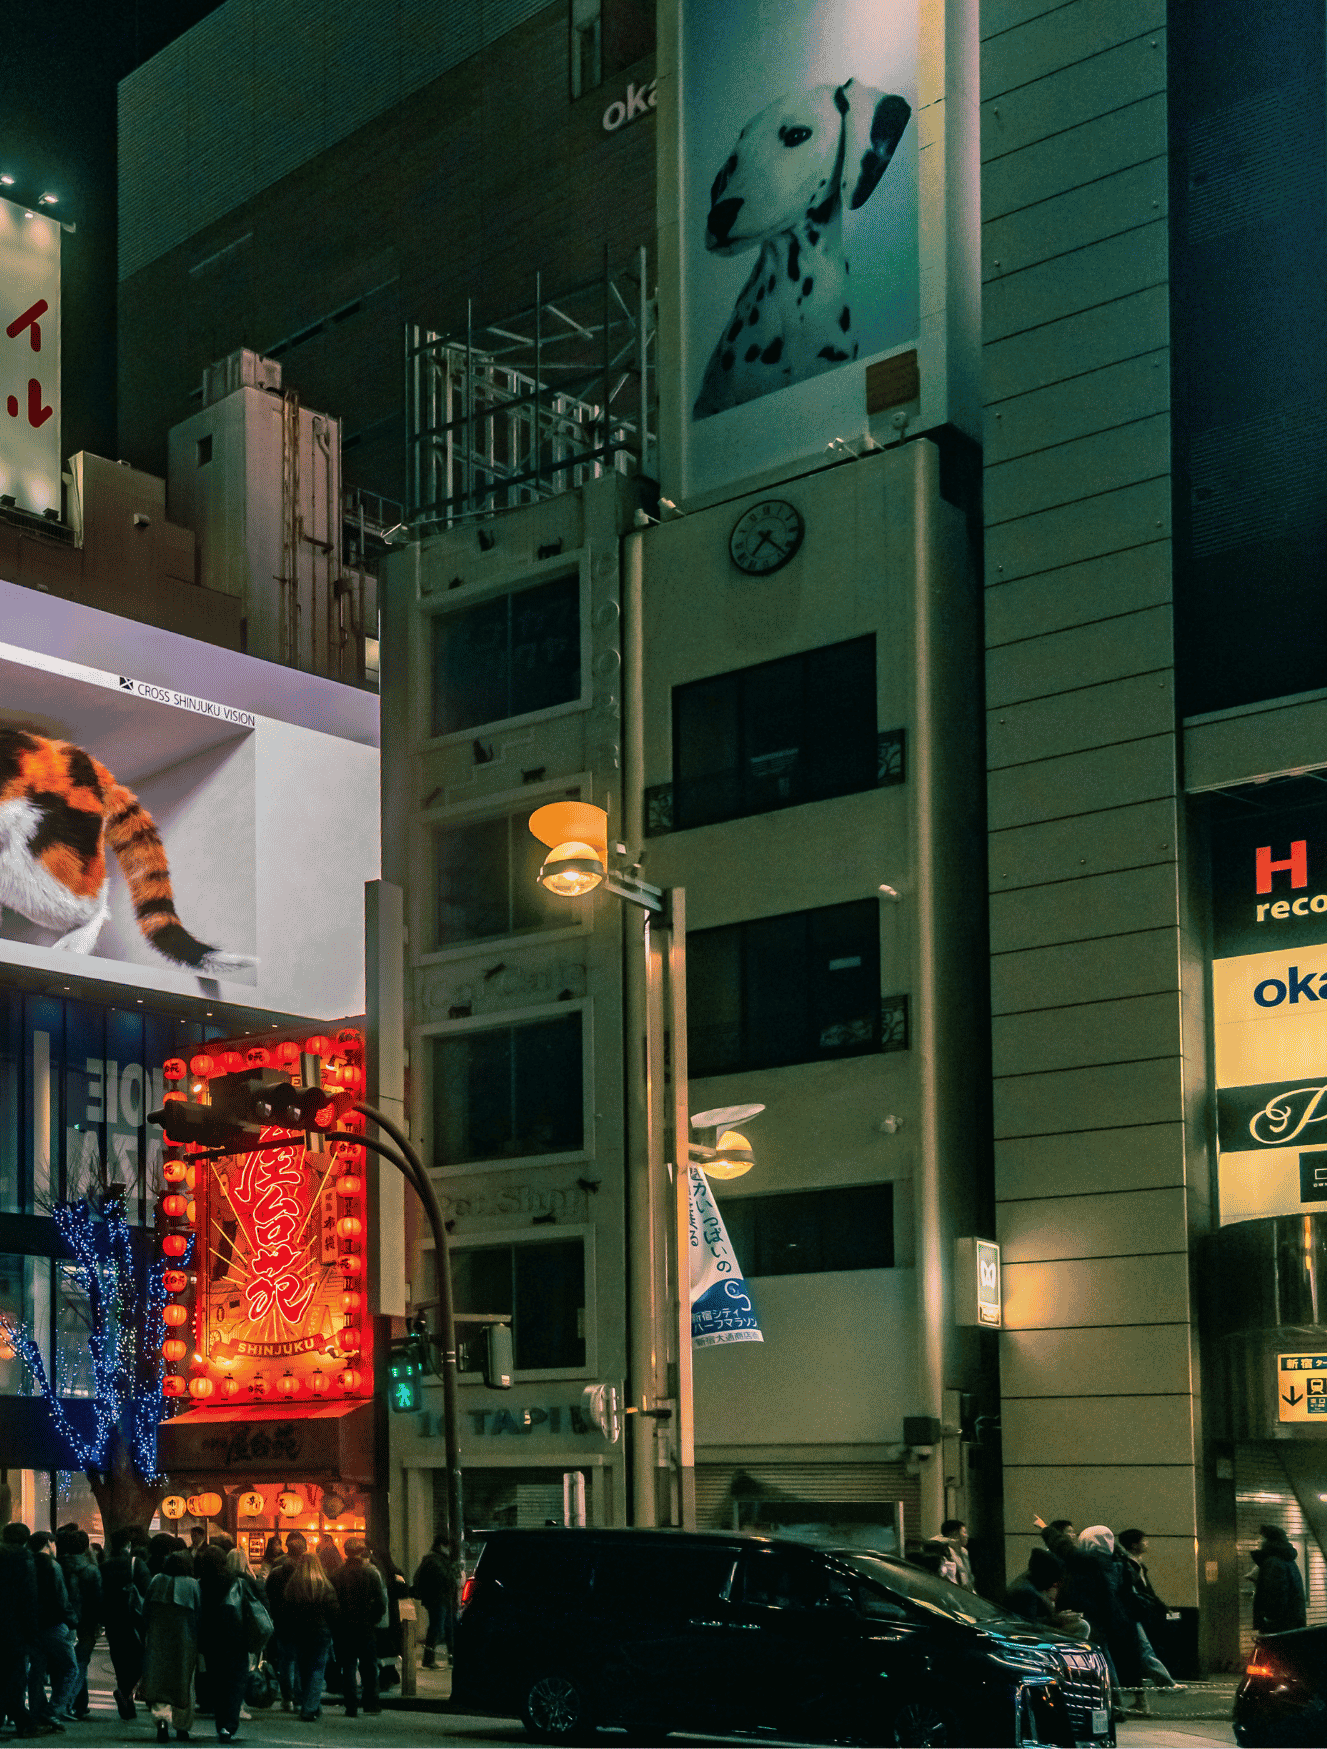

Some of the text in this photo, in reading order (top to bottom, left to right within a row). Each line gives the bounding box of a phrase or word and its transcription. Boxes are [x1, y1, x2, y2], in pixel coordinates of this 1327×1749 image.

[137, 683, 255, 727] CROSS SHINJUKU VISION
[237, 1337, 316, 1357] SHINJUKU
